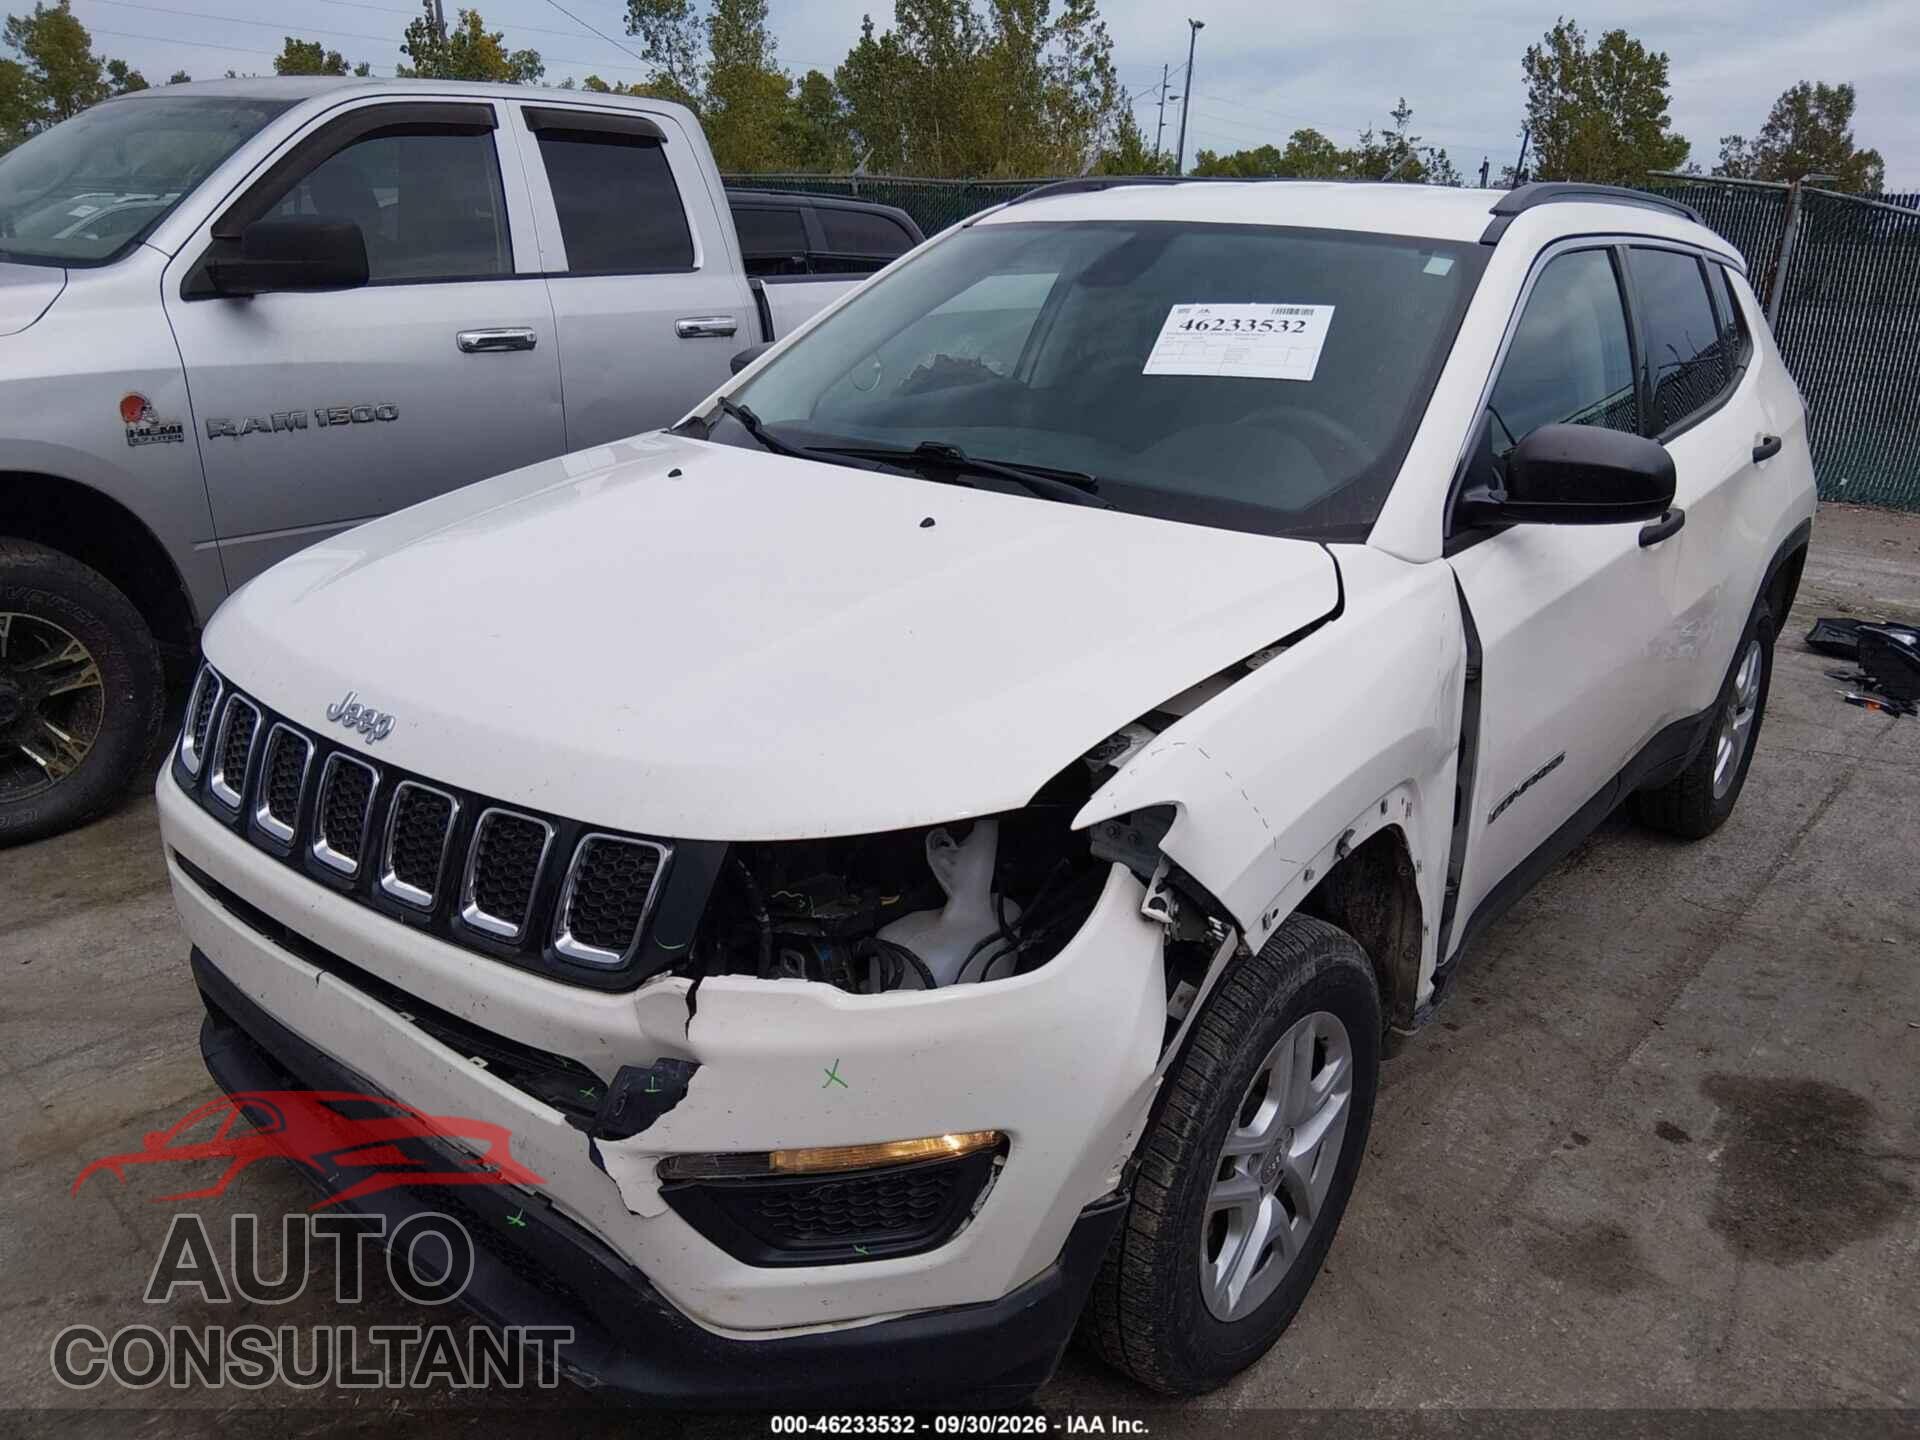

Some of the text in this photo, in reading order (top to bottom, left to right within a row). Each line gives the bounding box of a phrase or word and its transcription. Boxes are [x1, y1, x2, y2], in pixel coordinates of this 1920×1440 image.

[1179, 318, 1306, 334] 46233532
[206, 402, 399, 440] RAM 1500
[326, 691, 396, 745] Jeep
